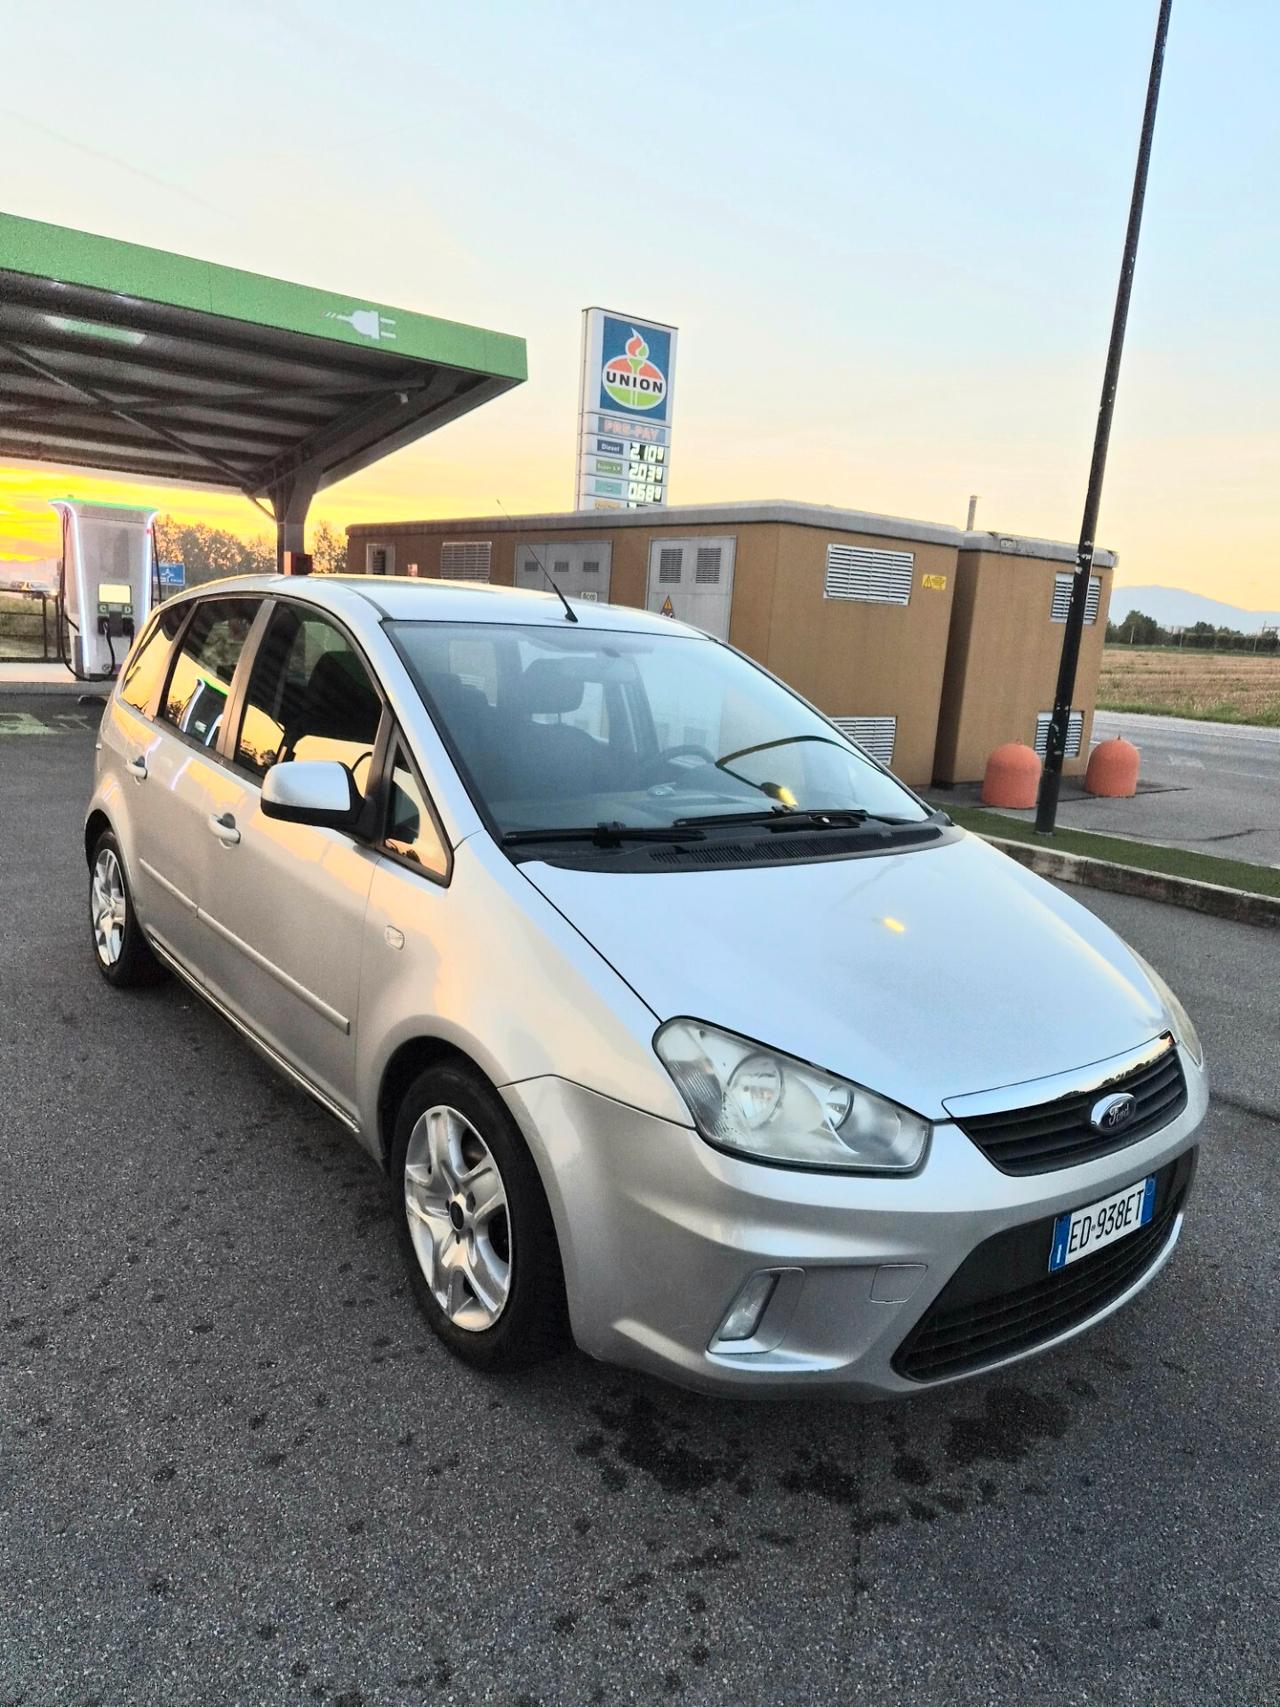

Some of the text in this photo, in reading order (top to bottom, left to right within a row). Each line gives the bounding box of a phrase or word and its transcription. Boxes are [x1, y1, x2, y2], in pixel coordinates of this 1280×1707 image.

[606, 371, 663, 393] UNION
[601, 443, 620, 452] Diesel
[1108, 1103, 1130, 1126] Ford
